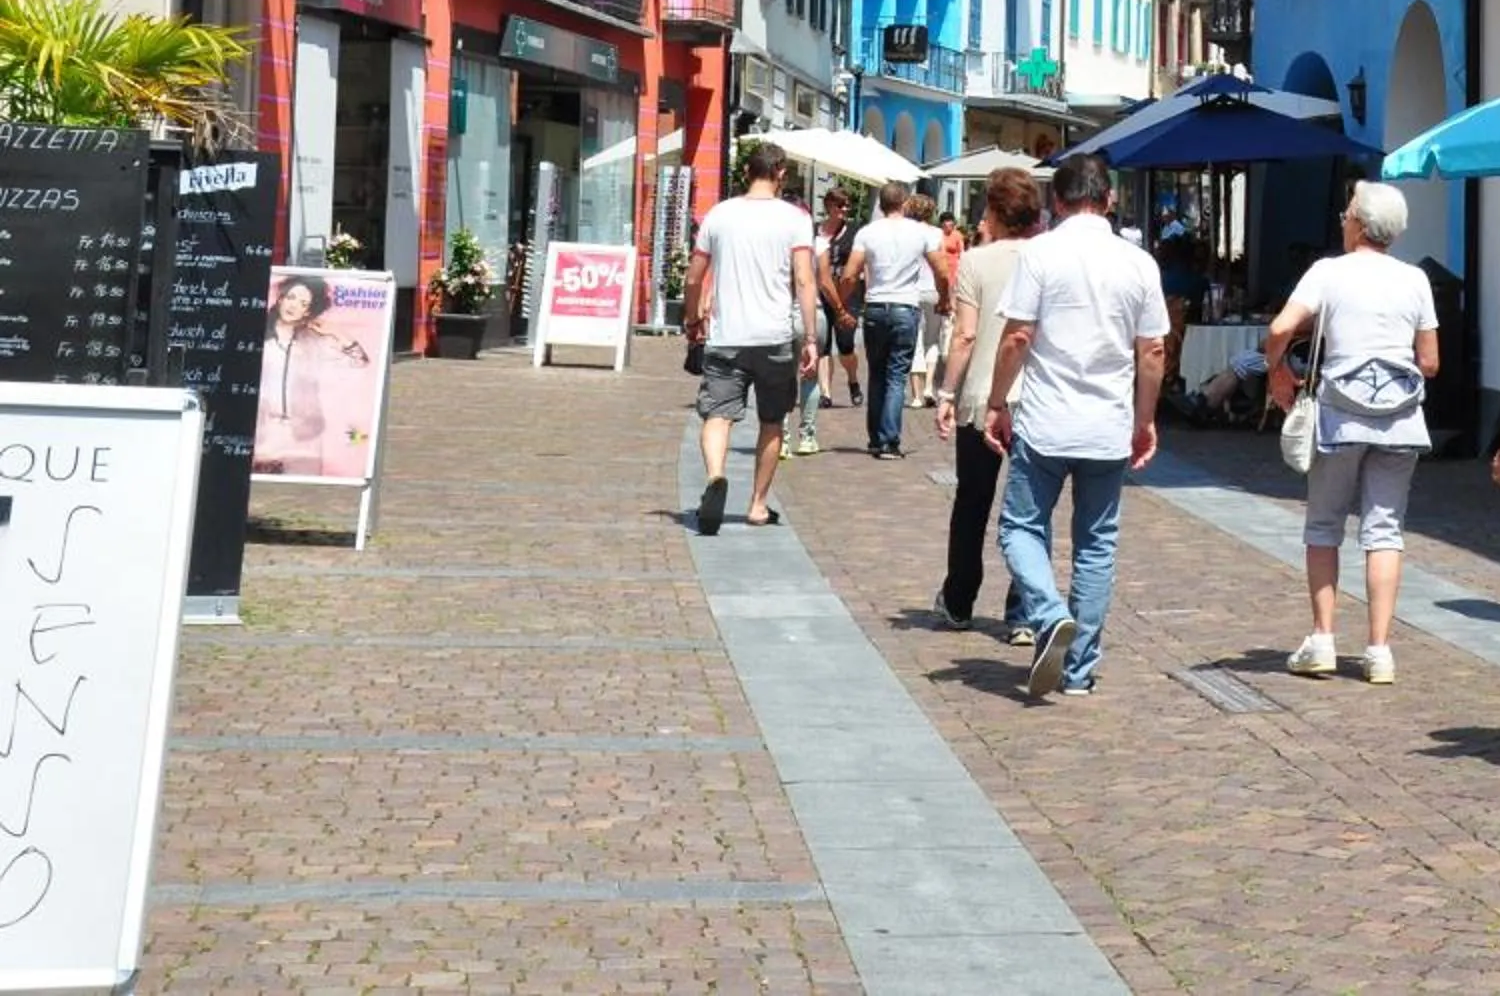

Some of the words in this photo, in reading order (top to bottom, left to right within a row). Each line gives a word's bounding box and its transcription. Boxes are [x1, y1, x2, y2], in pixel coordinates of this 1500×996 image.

[0, 188, 80, 211] IZZAS
[553, 262, 625, 293] -50%
[334, 293, 386, 309] Corner
